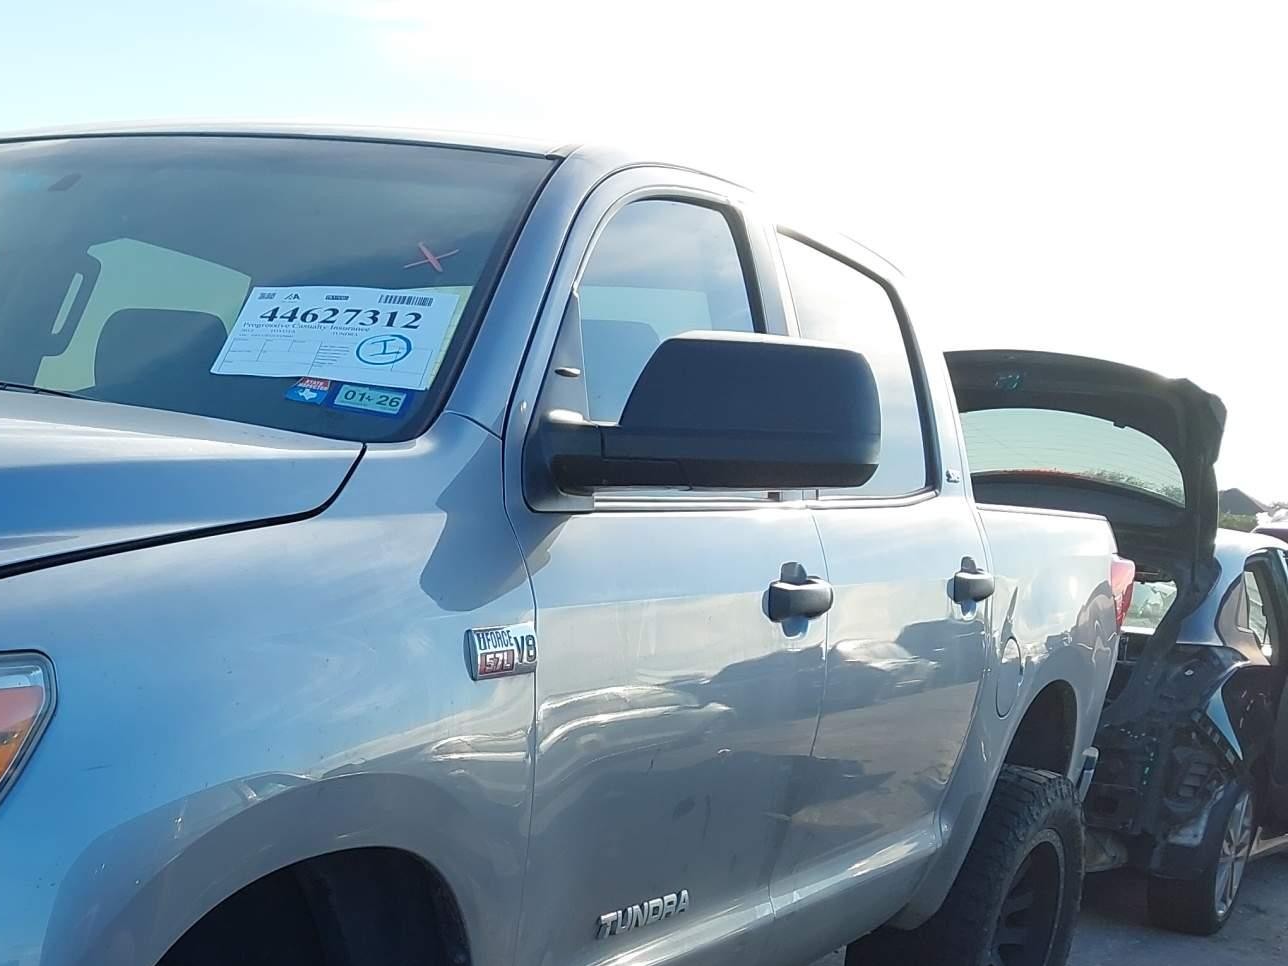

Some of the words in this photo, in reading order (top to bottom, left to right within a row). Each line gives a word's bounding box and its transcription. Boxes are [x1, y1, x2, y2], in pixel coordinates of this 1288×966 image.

[260, 306, 422, 329] 44627312
[292, 323, 327, 331] Casualty
[376, 395, 402, 407] 26
[513, 634, 537, 663] V8
[597, 889, 690, 939] TUNDRA
